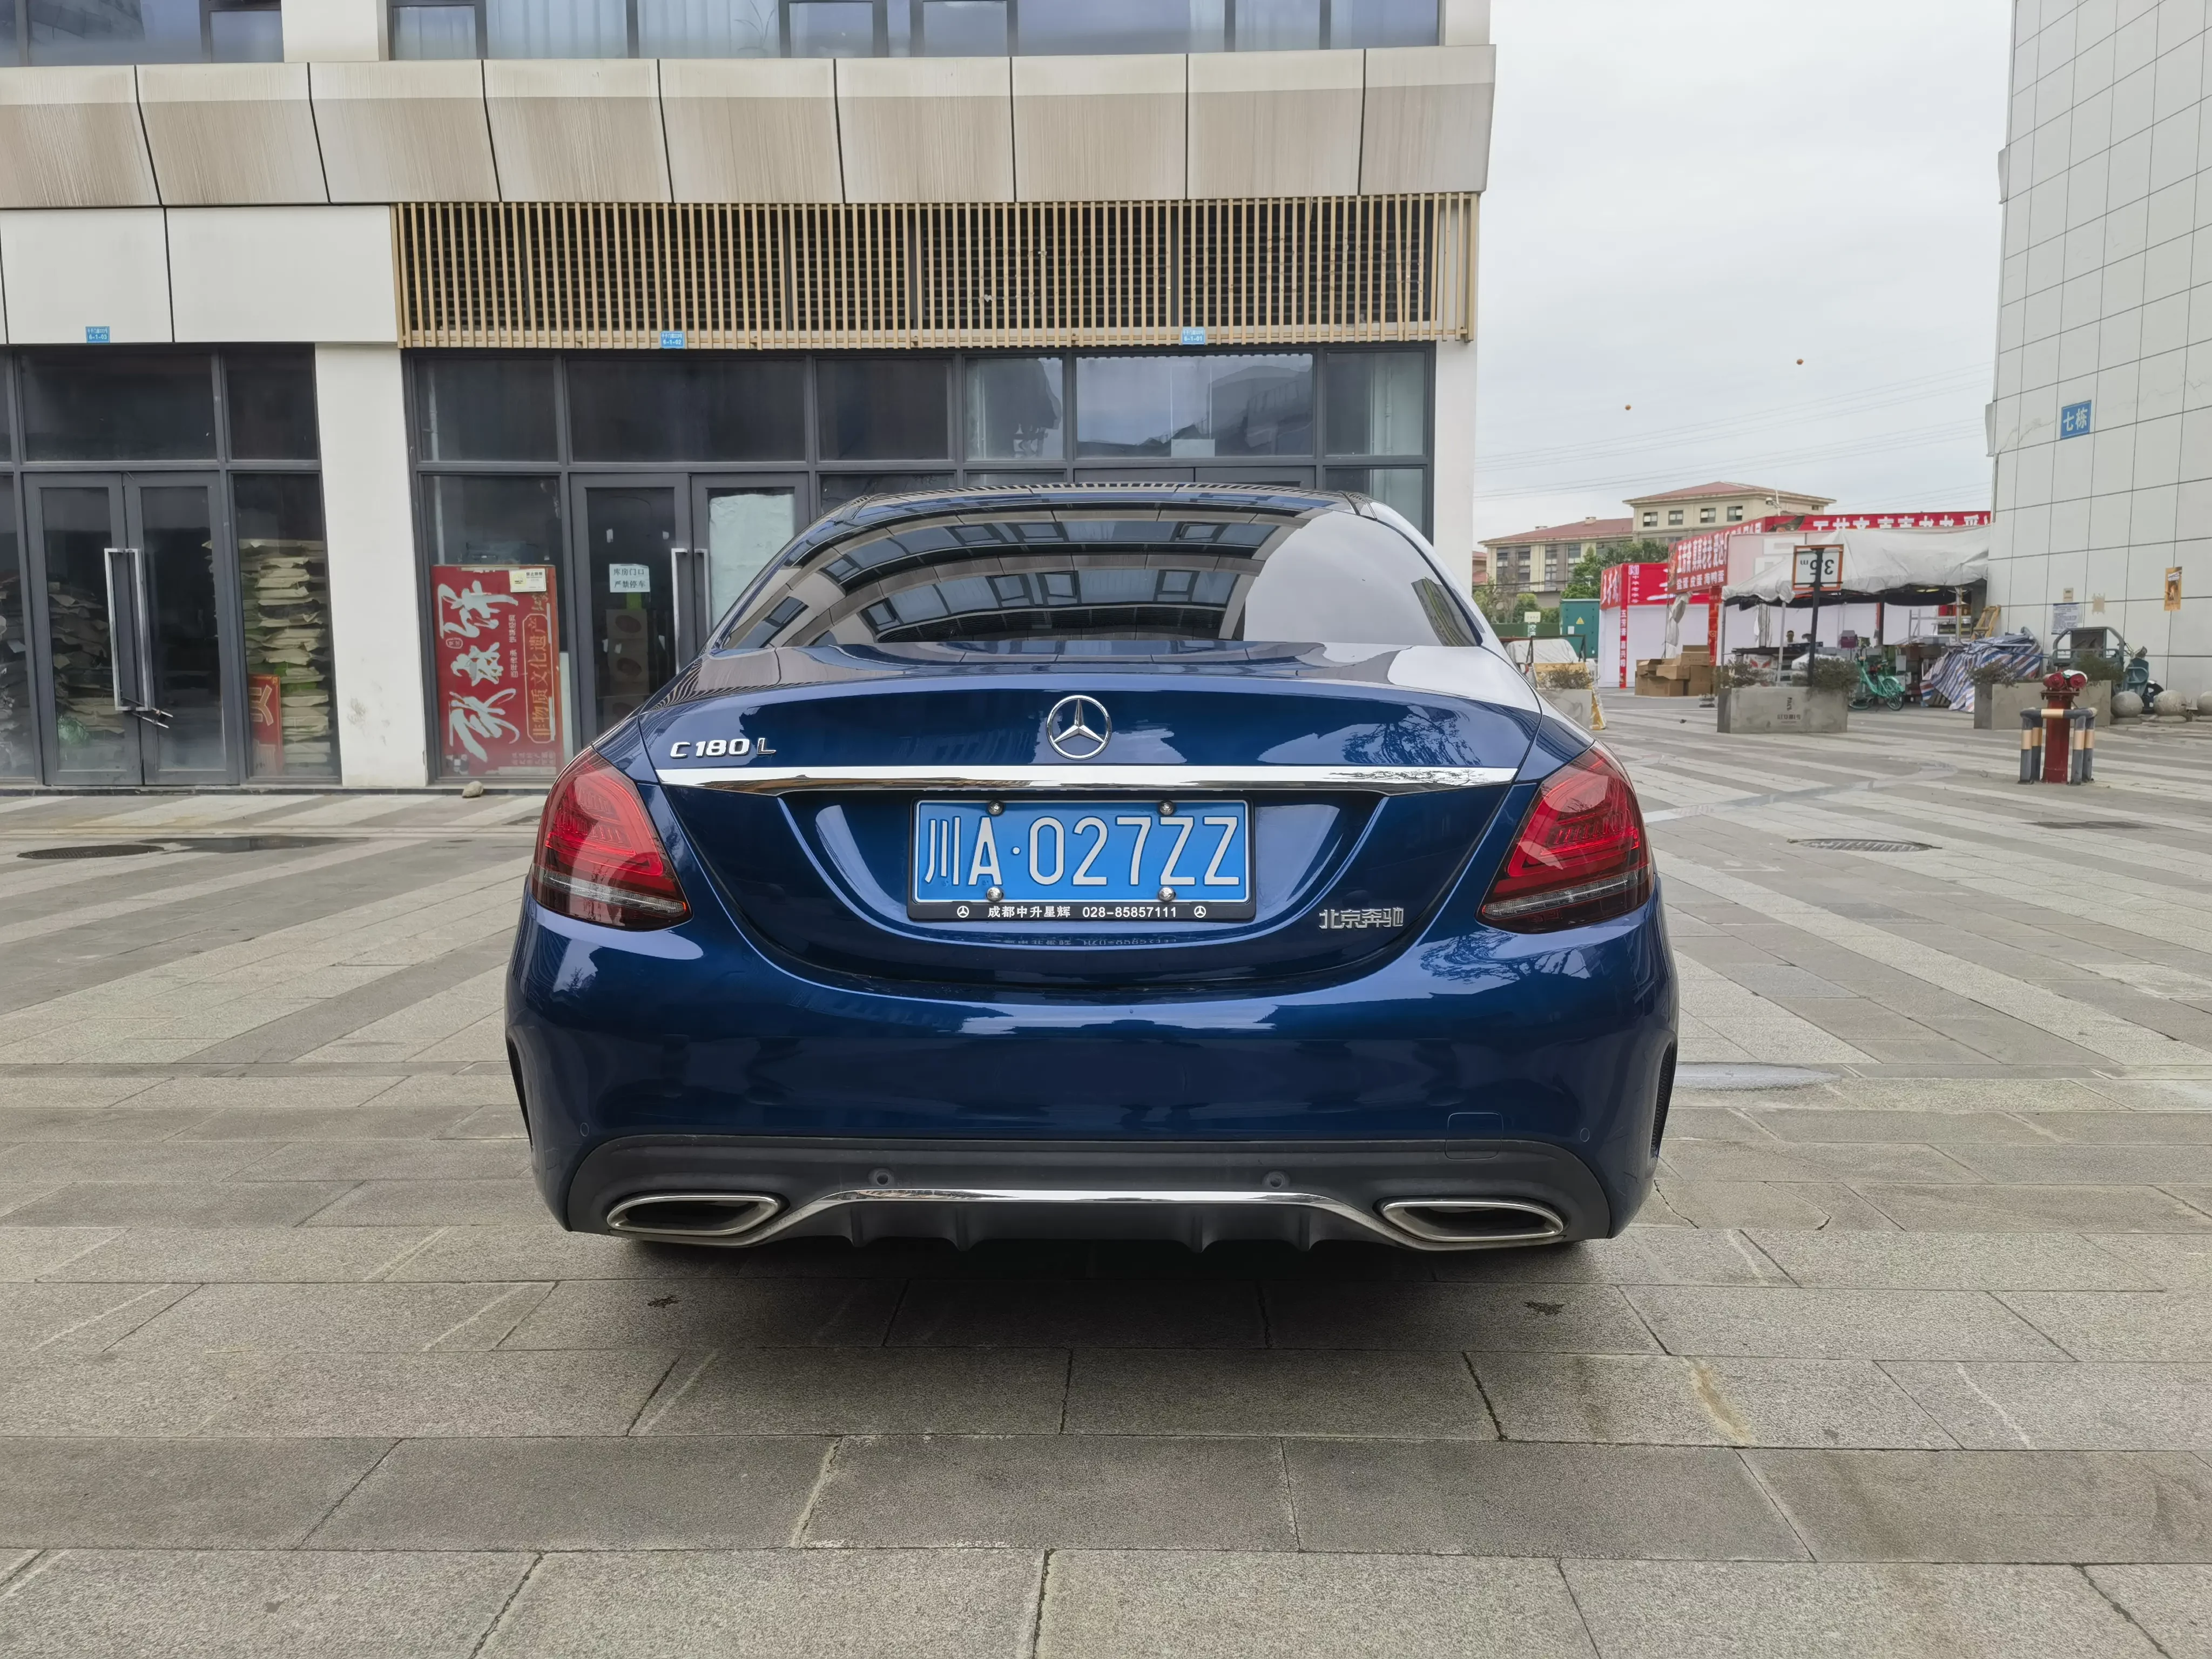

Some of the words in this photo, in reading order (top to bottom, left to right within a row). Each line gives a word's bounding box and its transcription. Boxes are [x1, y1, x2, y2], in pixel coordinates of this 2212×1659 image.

[613, 568, 645, 576] 库房门口
[614, 580, 646, 589] 严禁停车
[528, 616, 551, 737] 非物质文化遗产
[670, 741, 691, 759] C
[696, 738, 750, 757] 180
[756, 737, 777, 755] L
[987, 905, 1071, 919] 成都中升星辉
[1082, 906, 1177, 918] 028-85857111
[1319, 907, 1404, 929] 北京奔驰
